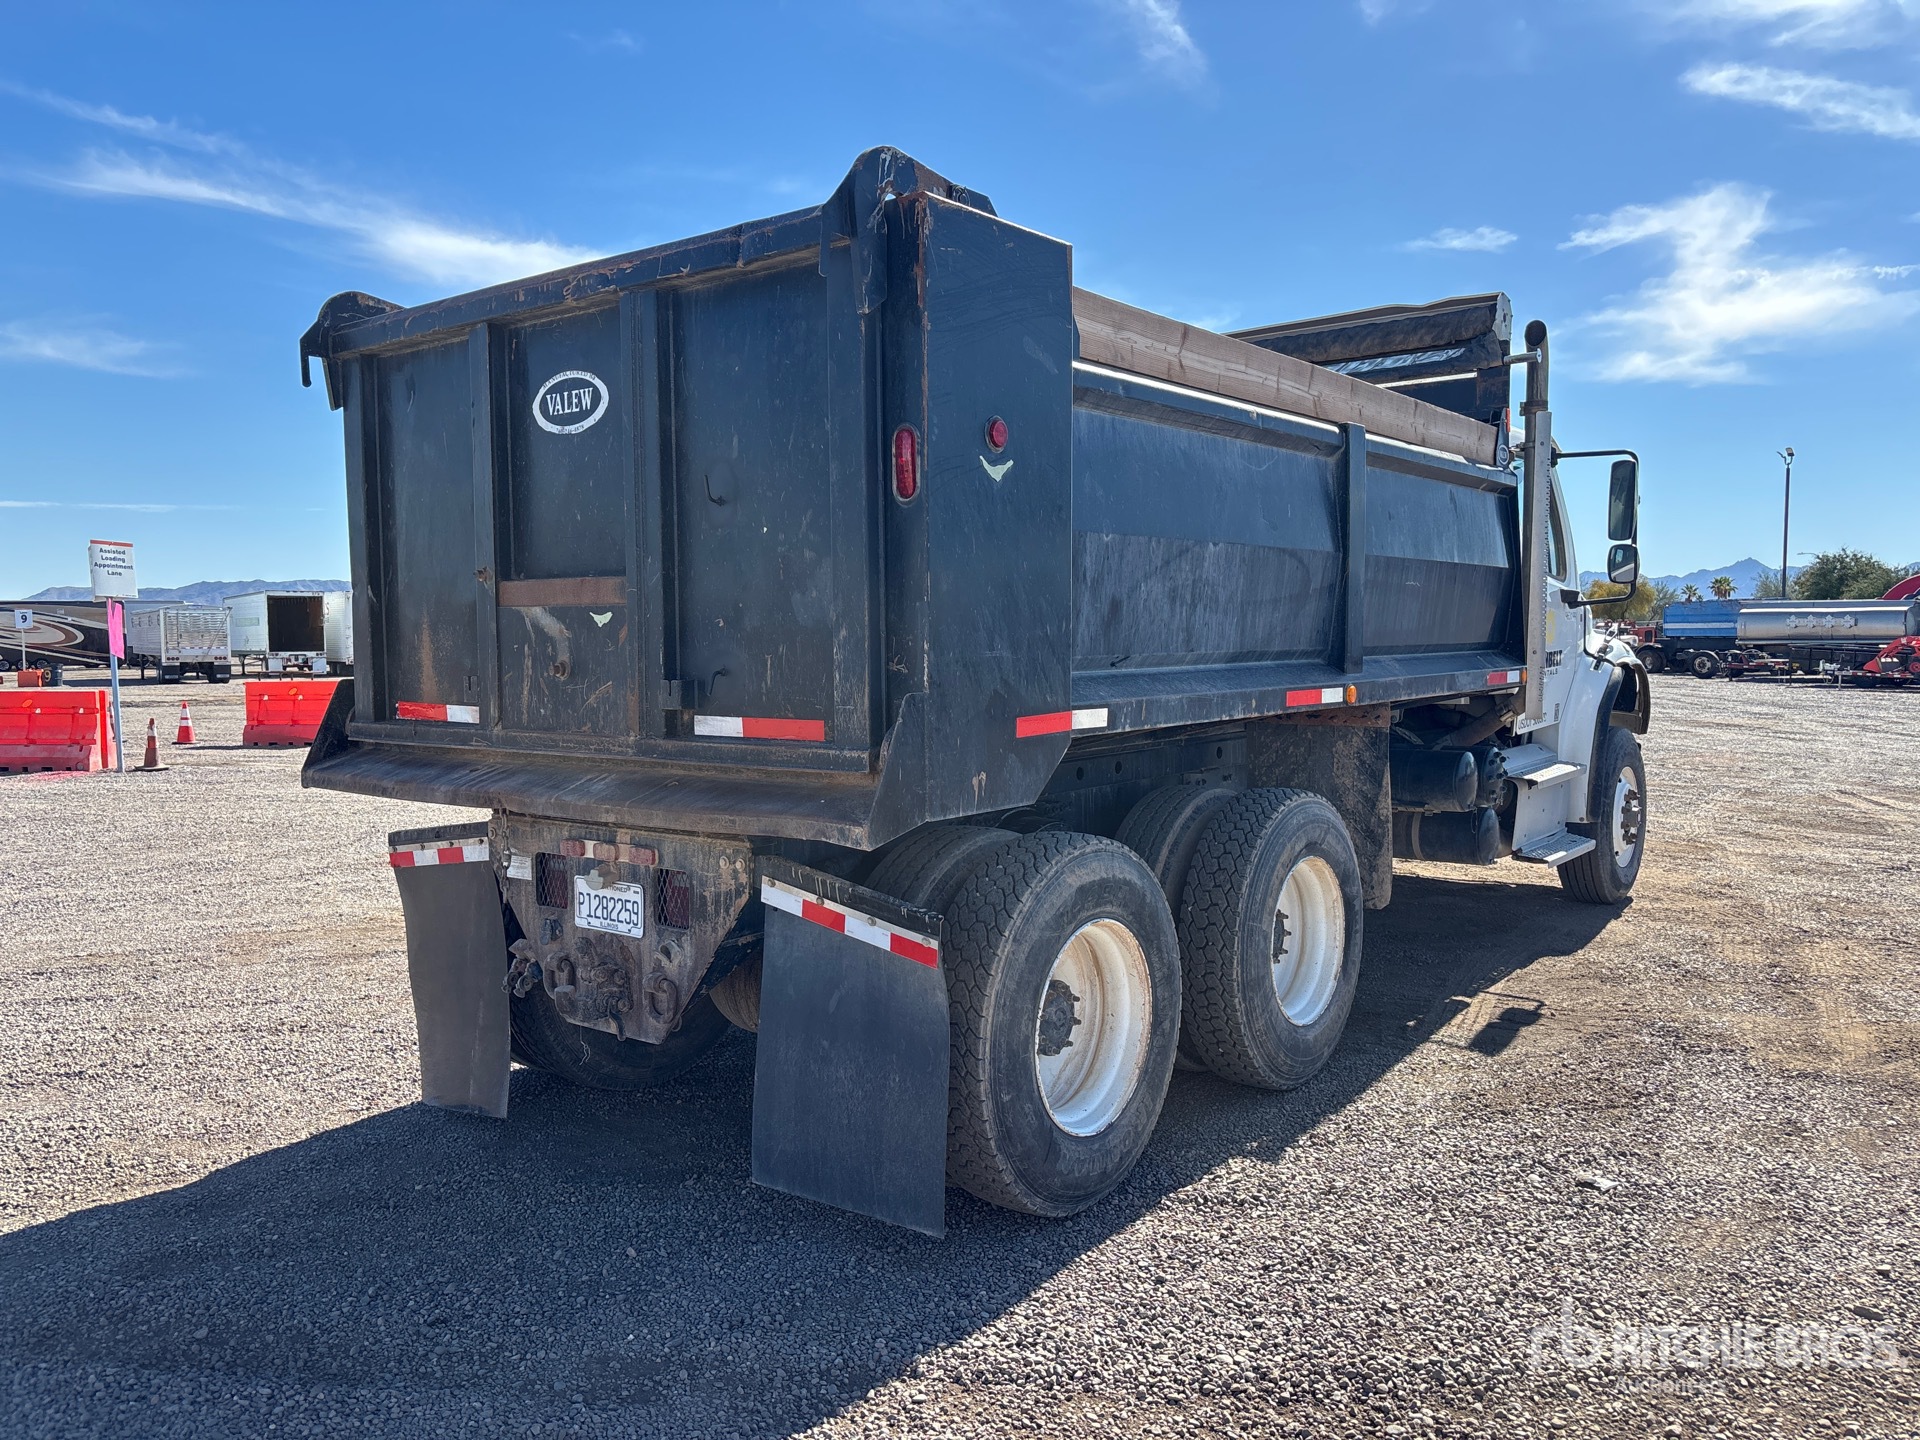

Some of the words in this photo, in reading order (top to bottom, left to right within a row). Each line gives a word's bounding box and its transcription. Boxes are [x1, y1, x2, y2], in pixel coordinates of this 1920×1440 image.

[546, 387, 594, 416] VALEW
[99, 547, 126, 555] Assisted
[101, 555, 126, 563] Loading
[94, 562, 134, 570] Appointment
[21, 614, 28, 623] 9
[578, 891, 639, 927] P1282259
[600, 921, 619, 930] ILLINOIS
